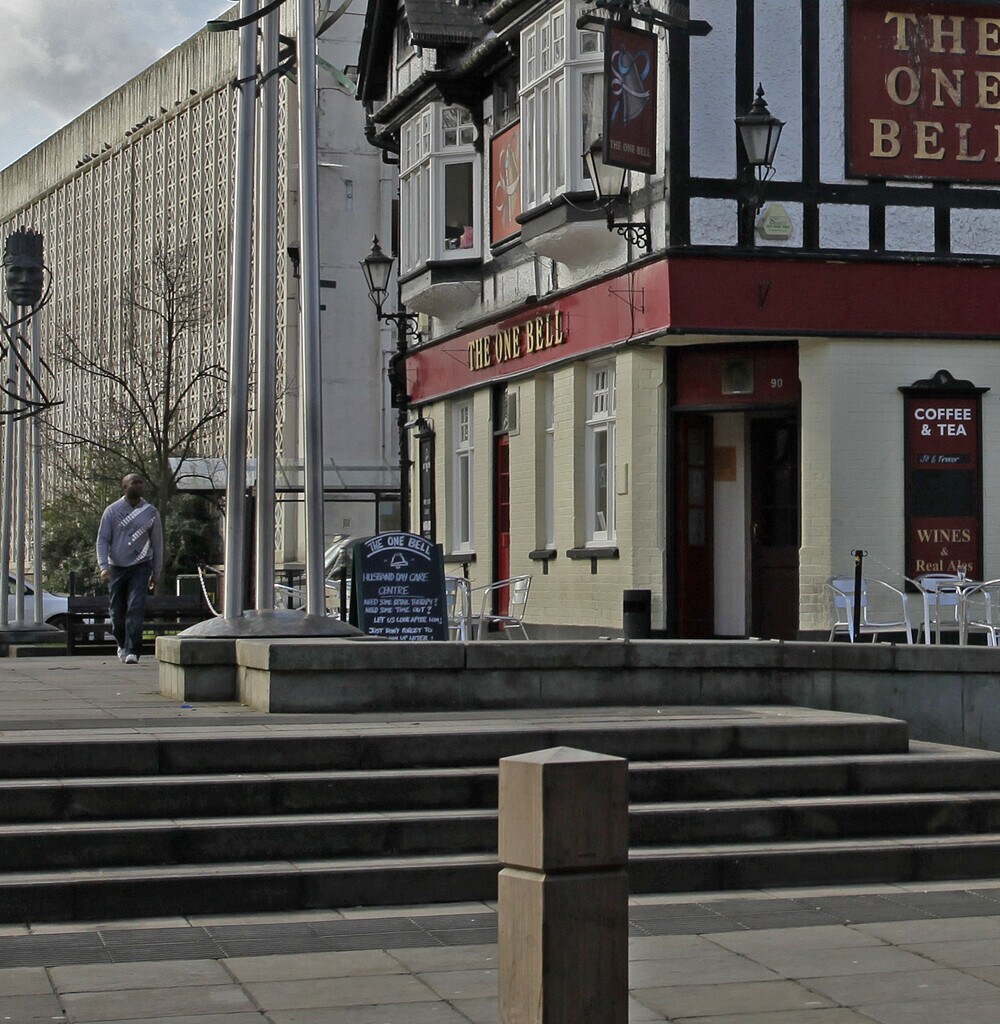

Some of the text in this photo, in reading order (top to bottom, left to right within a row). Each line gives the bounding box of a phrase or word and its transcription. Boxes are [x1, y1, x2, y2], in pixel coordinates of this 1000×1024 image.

[610, 139, 651, 157] THE ONE BELL
[467, 309, 563, 372] THE ONE BELL
[770, 378, 783, 388] 90
[914, 408, 972, 421] COFFEE
[921, 424, 967, 436] & TEA
[917, 529, 971, 543] WINES
[367, 536, 431, 555] THE ONE BELL
[940, 547, 949, 556] &
[915, 559, 943, 572] Real
[362, 572, 395, 582] HUSBAND
[409, 572, 430, 582] CARE
[378, 586, 409, 595] CENTRE
